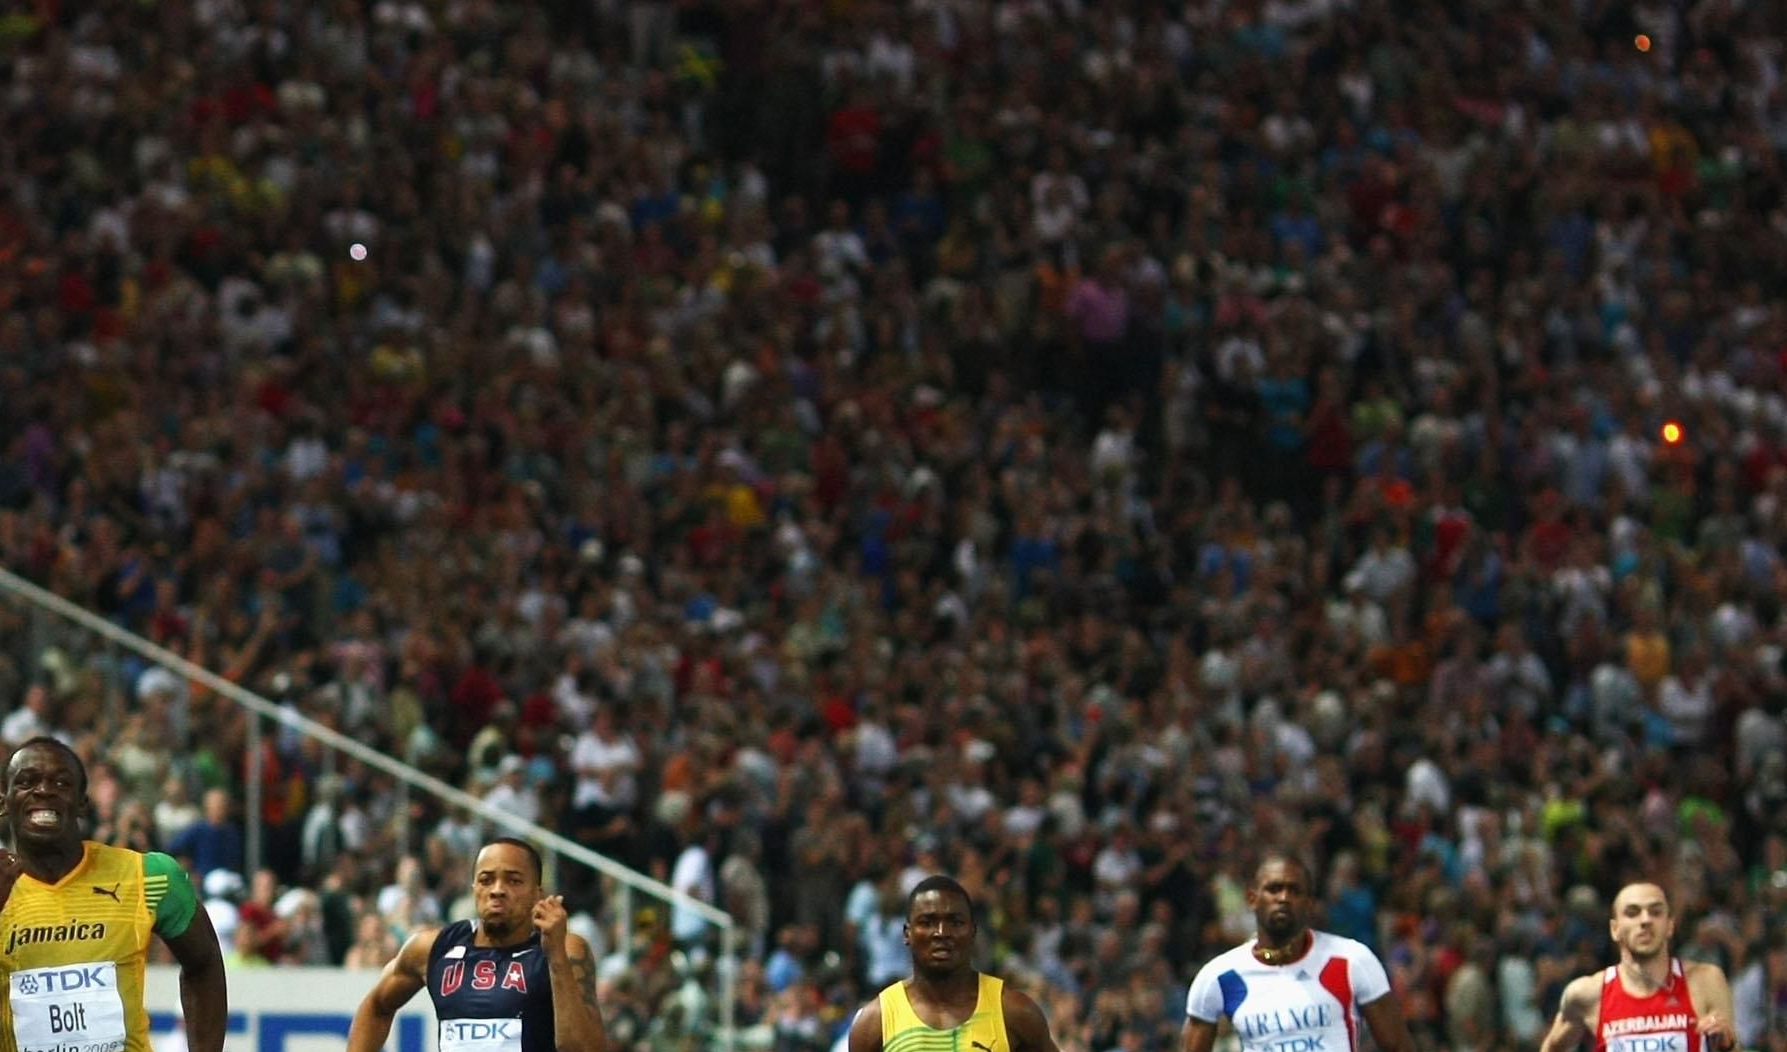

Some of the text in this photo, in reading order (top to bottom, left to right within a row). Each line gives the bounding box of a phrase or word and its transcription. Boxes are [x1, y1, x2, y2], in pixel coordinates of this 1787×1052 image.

[5, 919, 105, 955] jamaica
[38, 967, 106, 992] TDK
[441, 960, 527, 997] USA
[49, 1002, 87, 1033] Bolt
[1603, 1014, 1688, 1039] AZERBAIJAN
[455, 1023, 510, 1040] TDK
[1626, 1037, 1676, 1052] TDK
